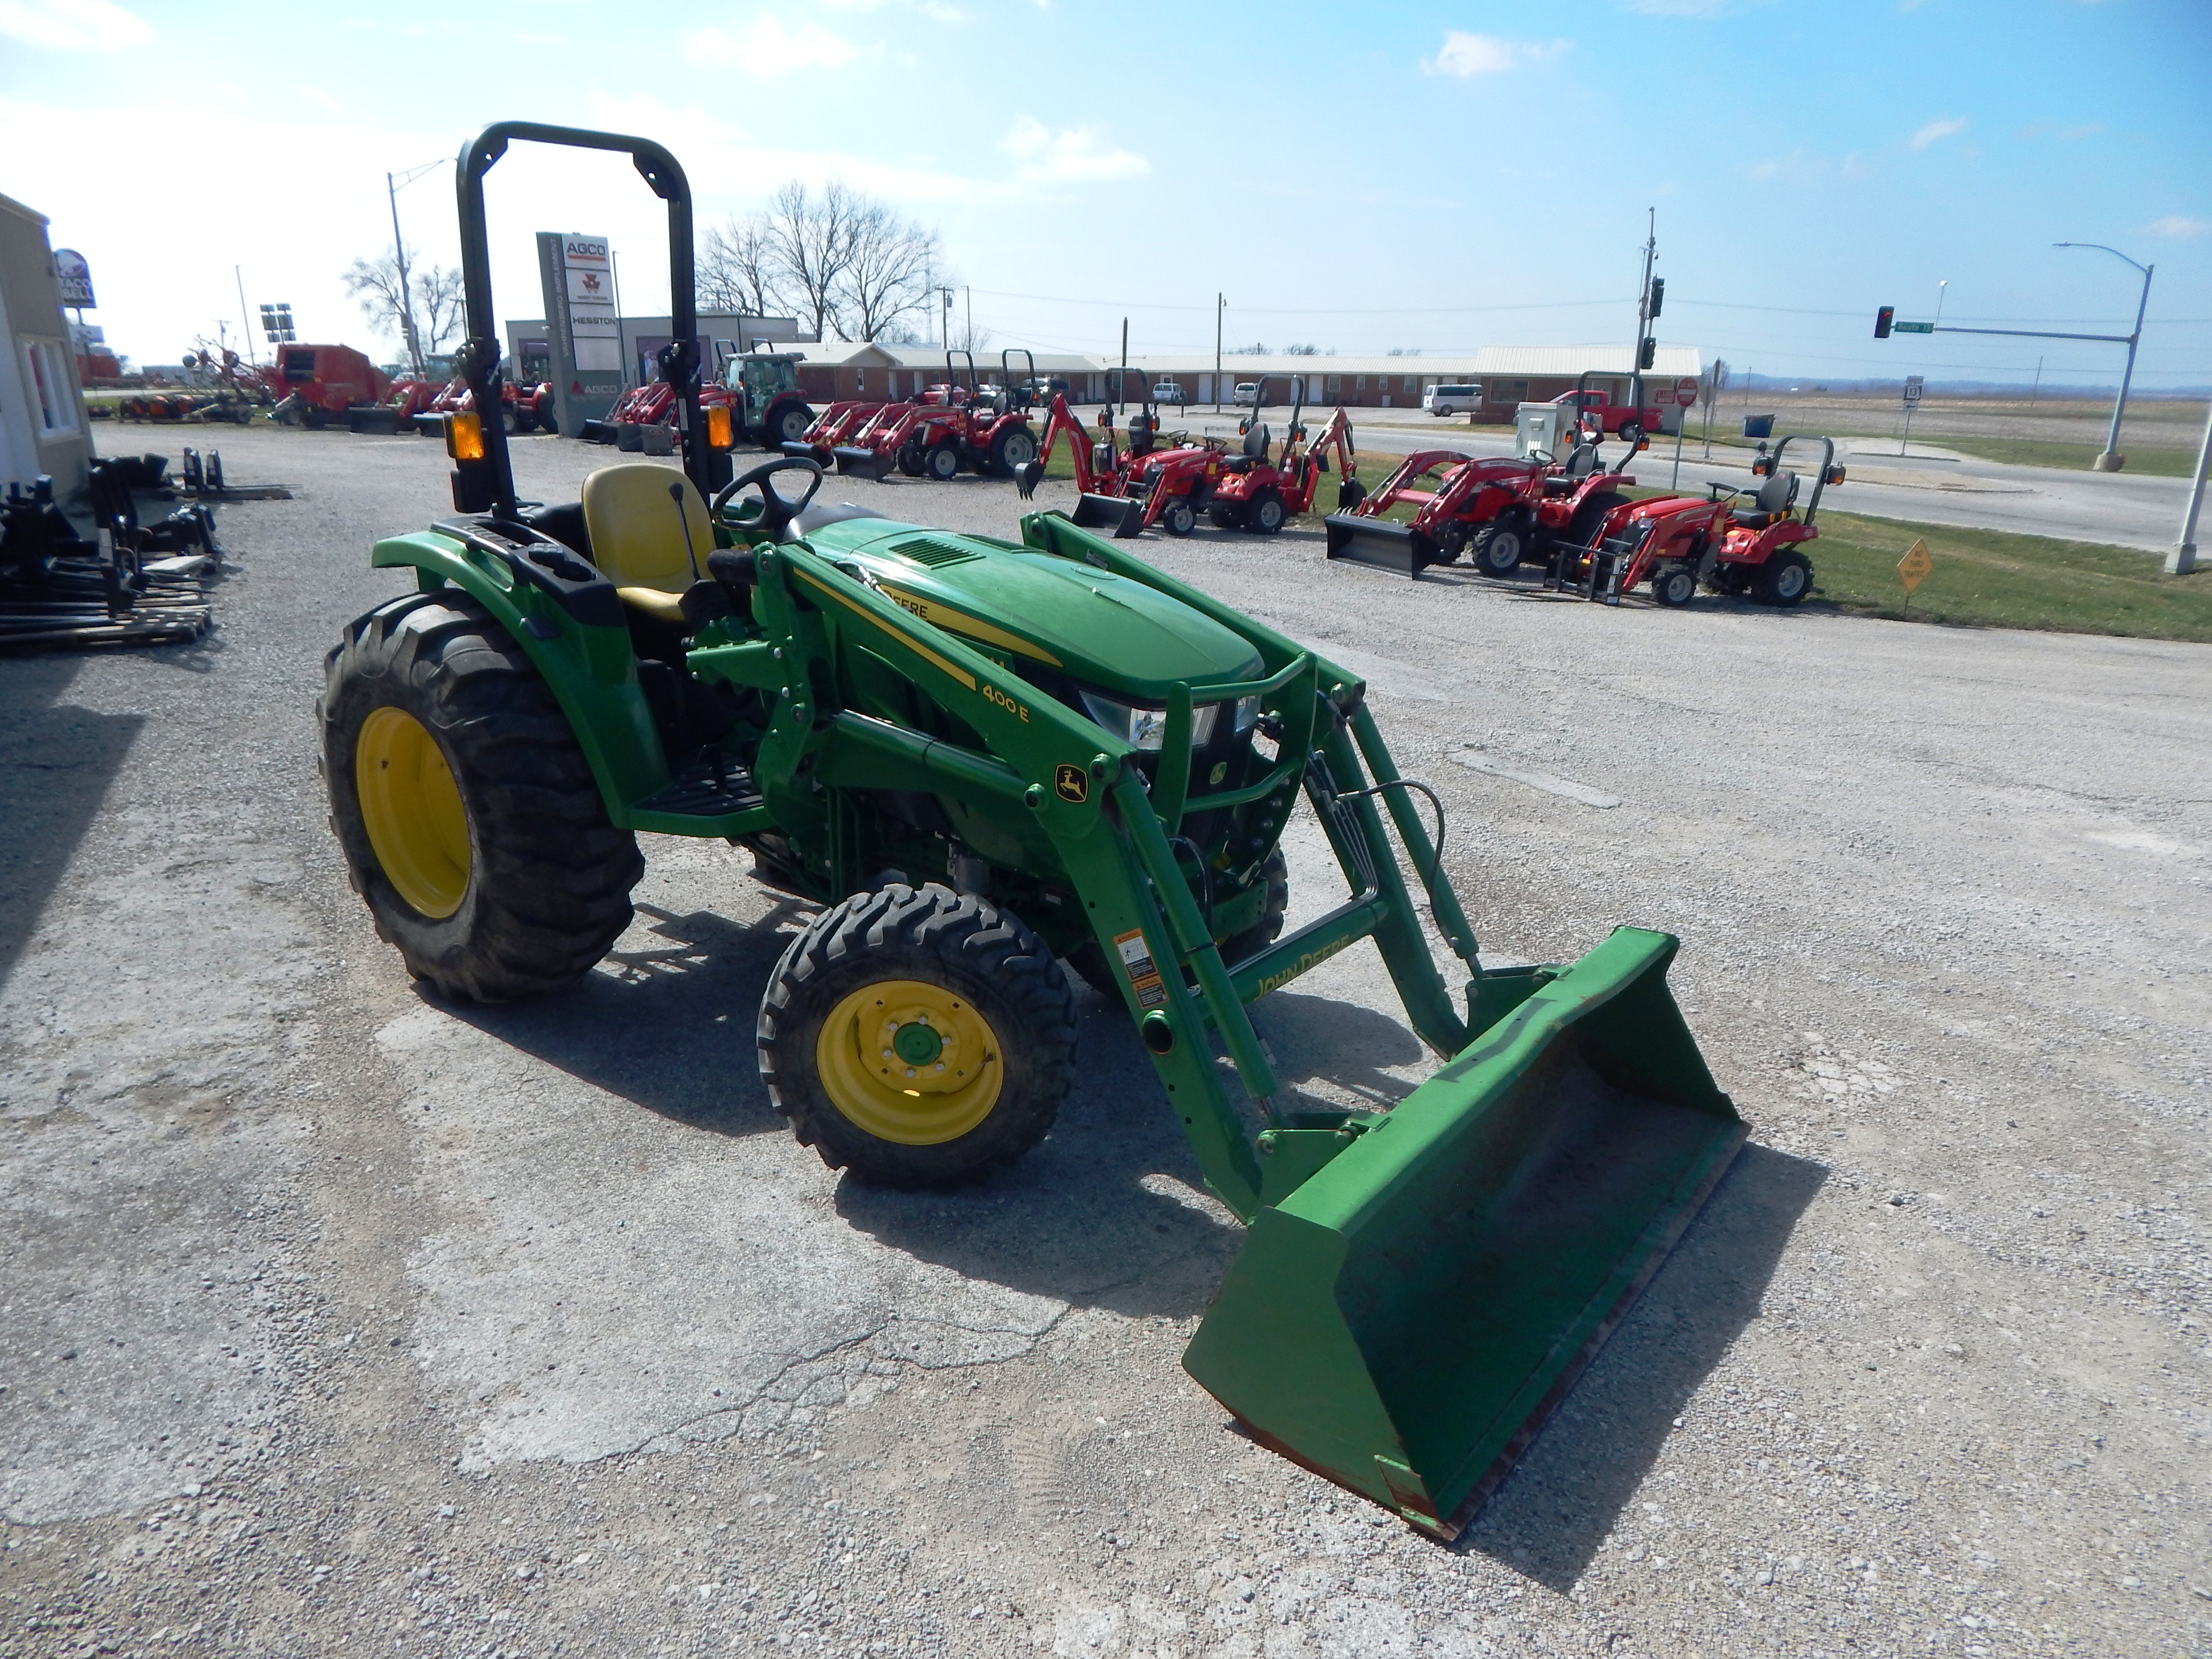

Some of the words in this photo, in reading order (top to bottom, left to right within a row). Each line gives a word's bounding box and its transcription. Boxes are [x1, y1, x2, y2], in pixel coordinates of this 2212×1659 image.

[566, 242, 606, 255] AGCO
[551, 238, 562, 293] IMPLEMENT
[58, 277, 92, 288] TACO
[63, 288, 95, 299] BELL
[573, 317, 615, 325] HESSTON
[584, 385, 617, 394] AGCO
[1909, 387, 1917, 396] 13
[1253, 964, 1298, 1002] JOHN
[1300, 935, 1349, 973] DEERE
